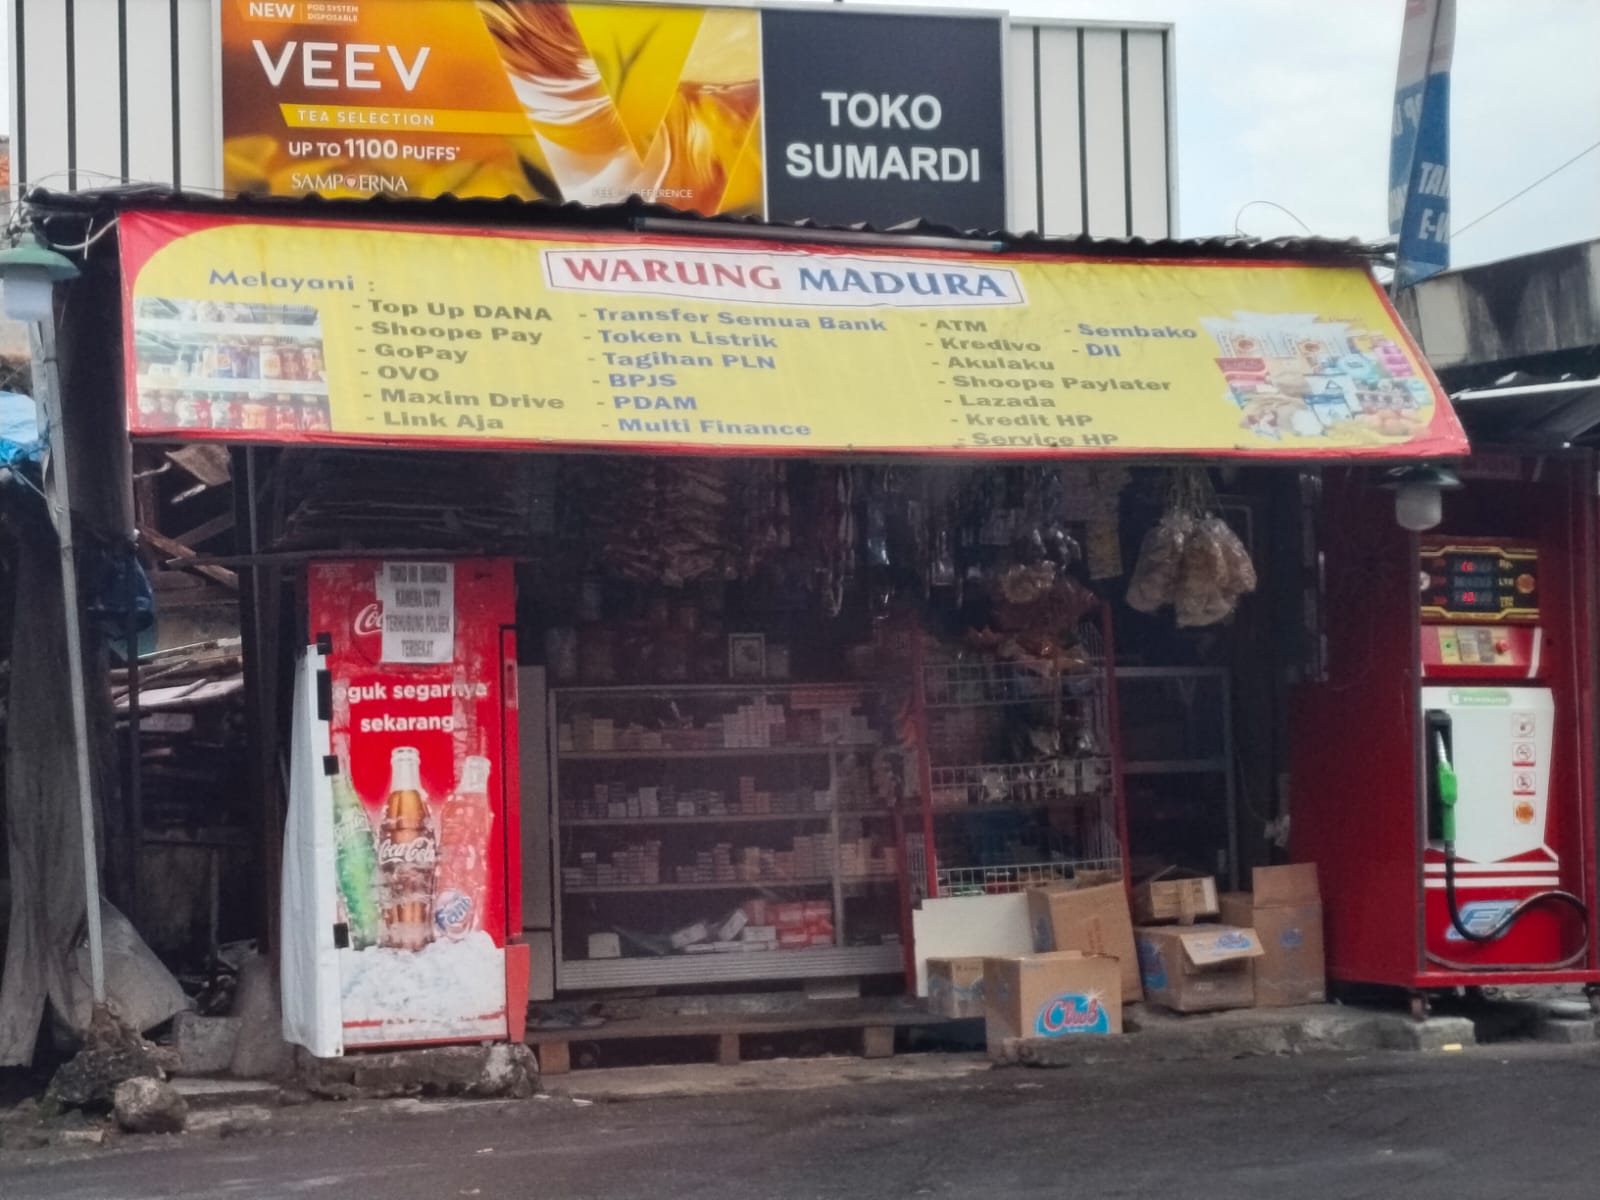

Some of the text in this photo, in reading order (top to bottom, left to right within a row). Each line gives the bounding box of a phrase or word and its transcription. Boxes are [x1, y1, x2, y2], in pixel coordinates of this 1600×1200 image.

[248, 3, 295, 18] NEW
[327, 4, 358, 13] SYSTEM
[252, 39, 431, 91] VEEV
[298, 110, 434, 126] TEA SELECTION
[821, 92, 943, 131] TOKO
[288, 141, 313, 156] UP
[317, 142, 341, 157] TO
[344, 138, 398, 159] 1100
[785, 142, 980, 183] SUMARDI
[208, 269, 355, 292] Melayani
[564, 257, 1008, 298] WARUNG MADURA
[368, 299, 552, 322] Top Up DANA
[594, 307, 888, 332] Transfer Semua Bank
[371, 321, 542, 345] Shoope Pay
[935, 318, 987, 333] ATM
[1077, 322, 1198, 340] Sembako
[598, 329, 778, 349] Token Listrik
[941, 337, 1042, 353] Kredivo
[375, 343, 468, 363] GoPay
[602, 351, 776, 370] Tagihan PLN
[378, 365, 439, 382] OVO
[947, 356, 1055, 372] Akulaku
[608, 373, 677, 388] BPJS
[952, 374, 1171, 394] Shoope Paylater
[381, 388, 565, 410] Maxim Drive
[613, 396, 697, 411] PDAM
[959, 394, 1057, 408] Lazada
[384, 411, 504, 431] Link Aja
[618, 418, 811, 437] Multi Finance
[965, 413, 1094, 428] Kredit HP
[971, 431, 1119, 447] Service HP
[393, 682, 488, 702] segarnya
[360, 713, 455, 733] sekarang
